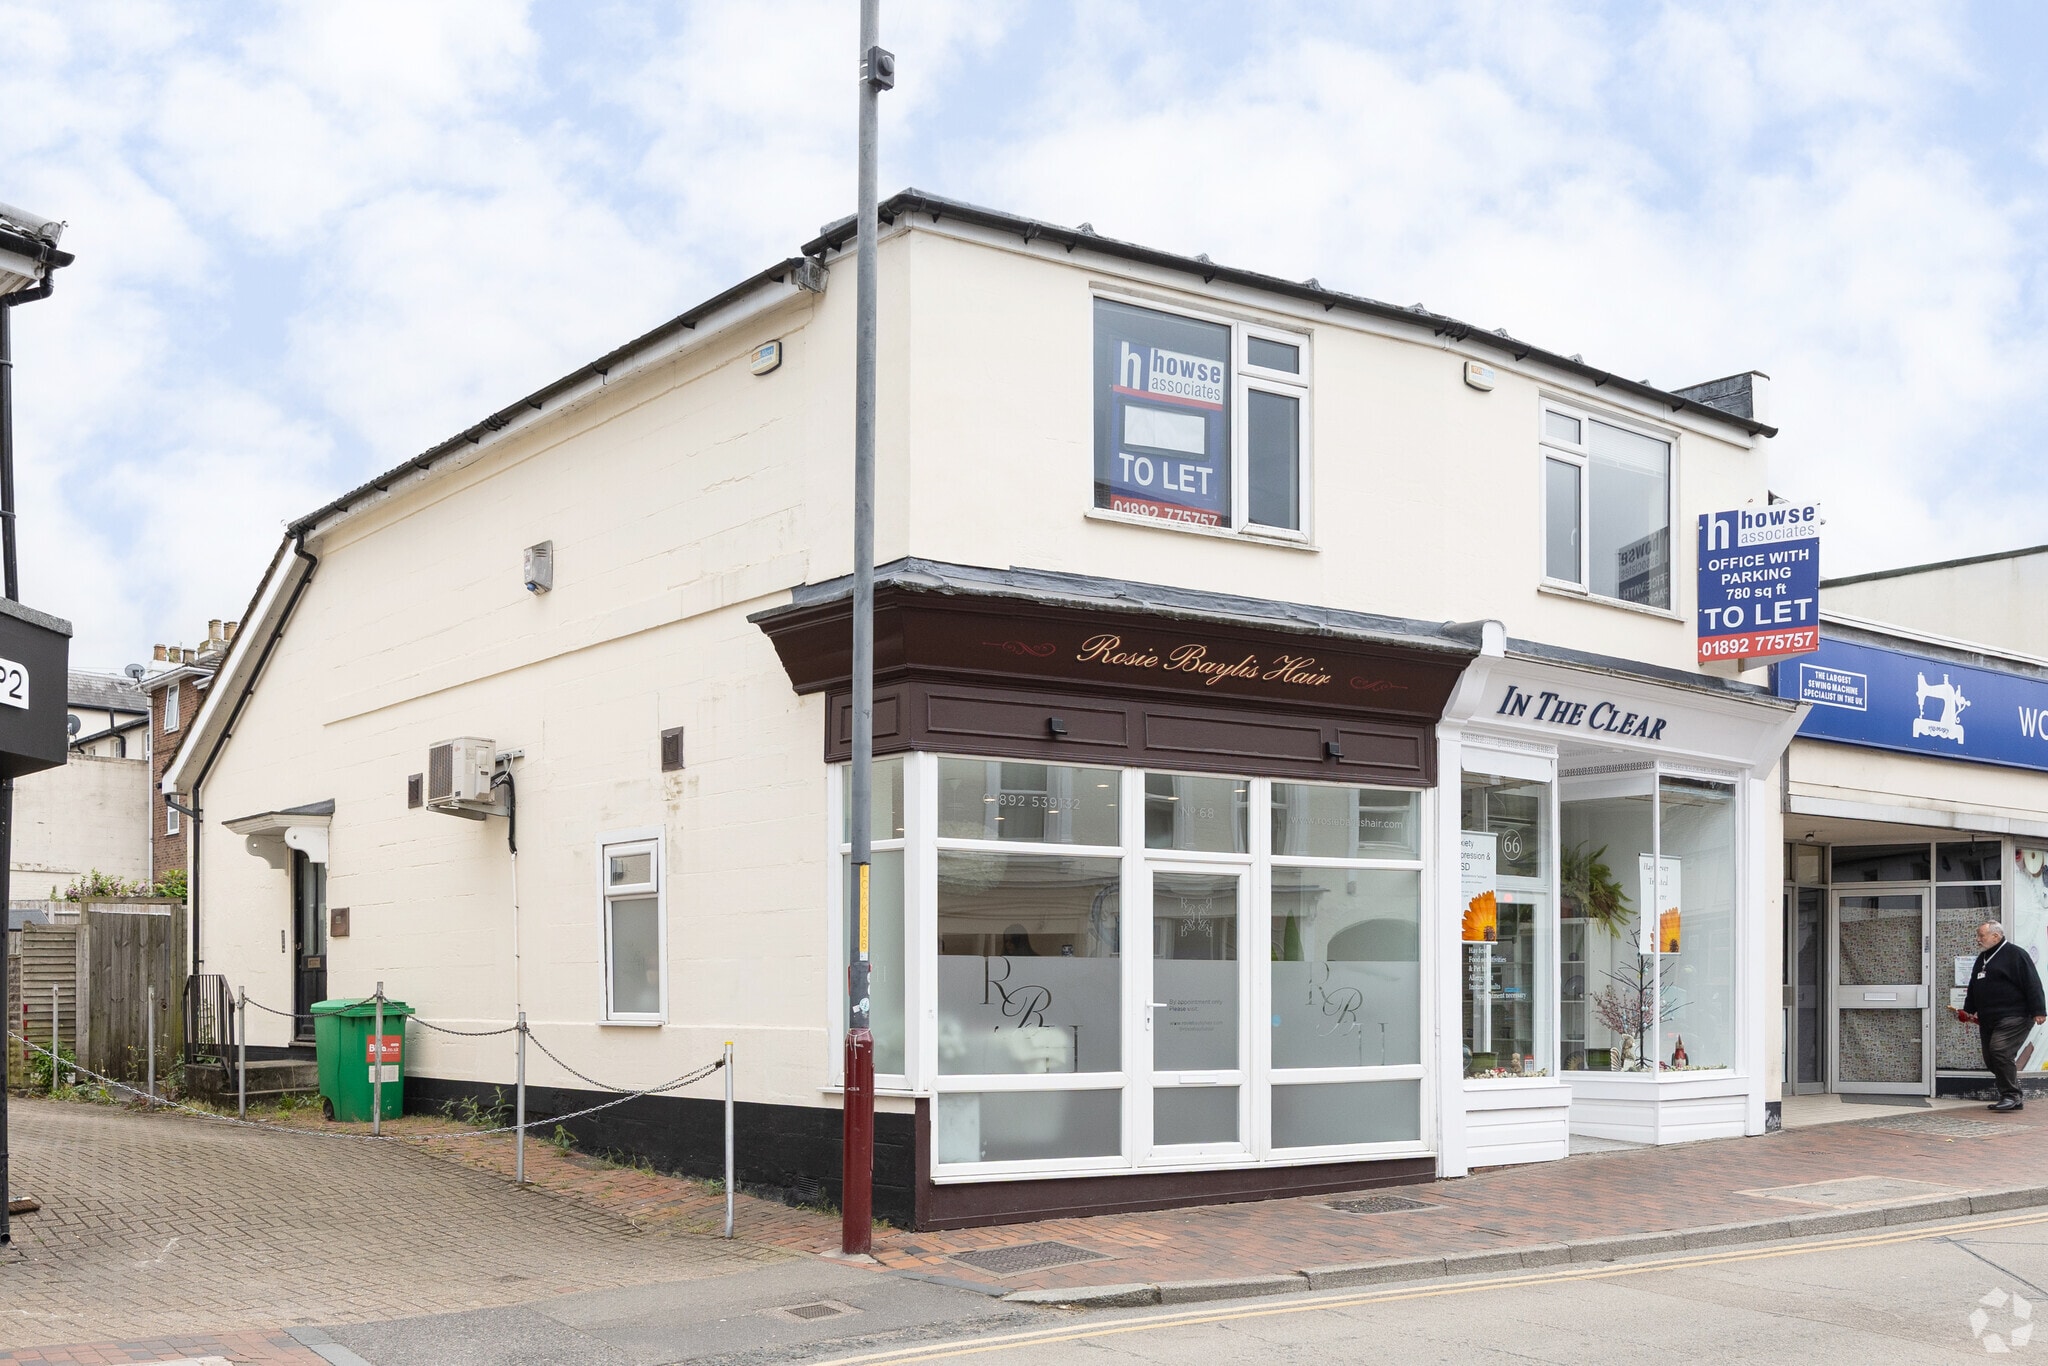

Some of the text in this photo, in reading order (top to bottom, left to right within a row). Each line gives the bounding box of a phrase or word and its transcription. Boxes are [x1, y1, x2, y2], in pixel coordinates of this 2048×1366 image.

[1120, 341, 1221, 390] h howse
[1151, 376, 1221, 401] associates
[1119, 452, 1213, 495] TO LET
[1113, 499, 1218, 528] 01892 775757
[1707, 505, 1815, 551] h howse
[1741, 522, 1815, 544] associates
[1708, 548, 1809, 572] OFFICE WITH
[1721, 567, 1792, 586] PARKING
[1726, 583, 1787, 601] 780 sq ft
[1704, 597, 1813, 630] TO LET
[1702, 631, 1814, 657] 01892 775757
[1076, 633, 1331, 687] Rosie Baylis Hair
[1808, 679, 1858, 695] SEWING MACHINE
[1815, 671, 1851, 684] THE LARGEST
[1803, 688, 1863, 705] SPECIALIST IN THE UK
[1199, 807, 1214, 819] 68
[1503, 836, 1520, 854] 66
